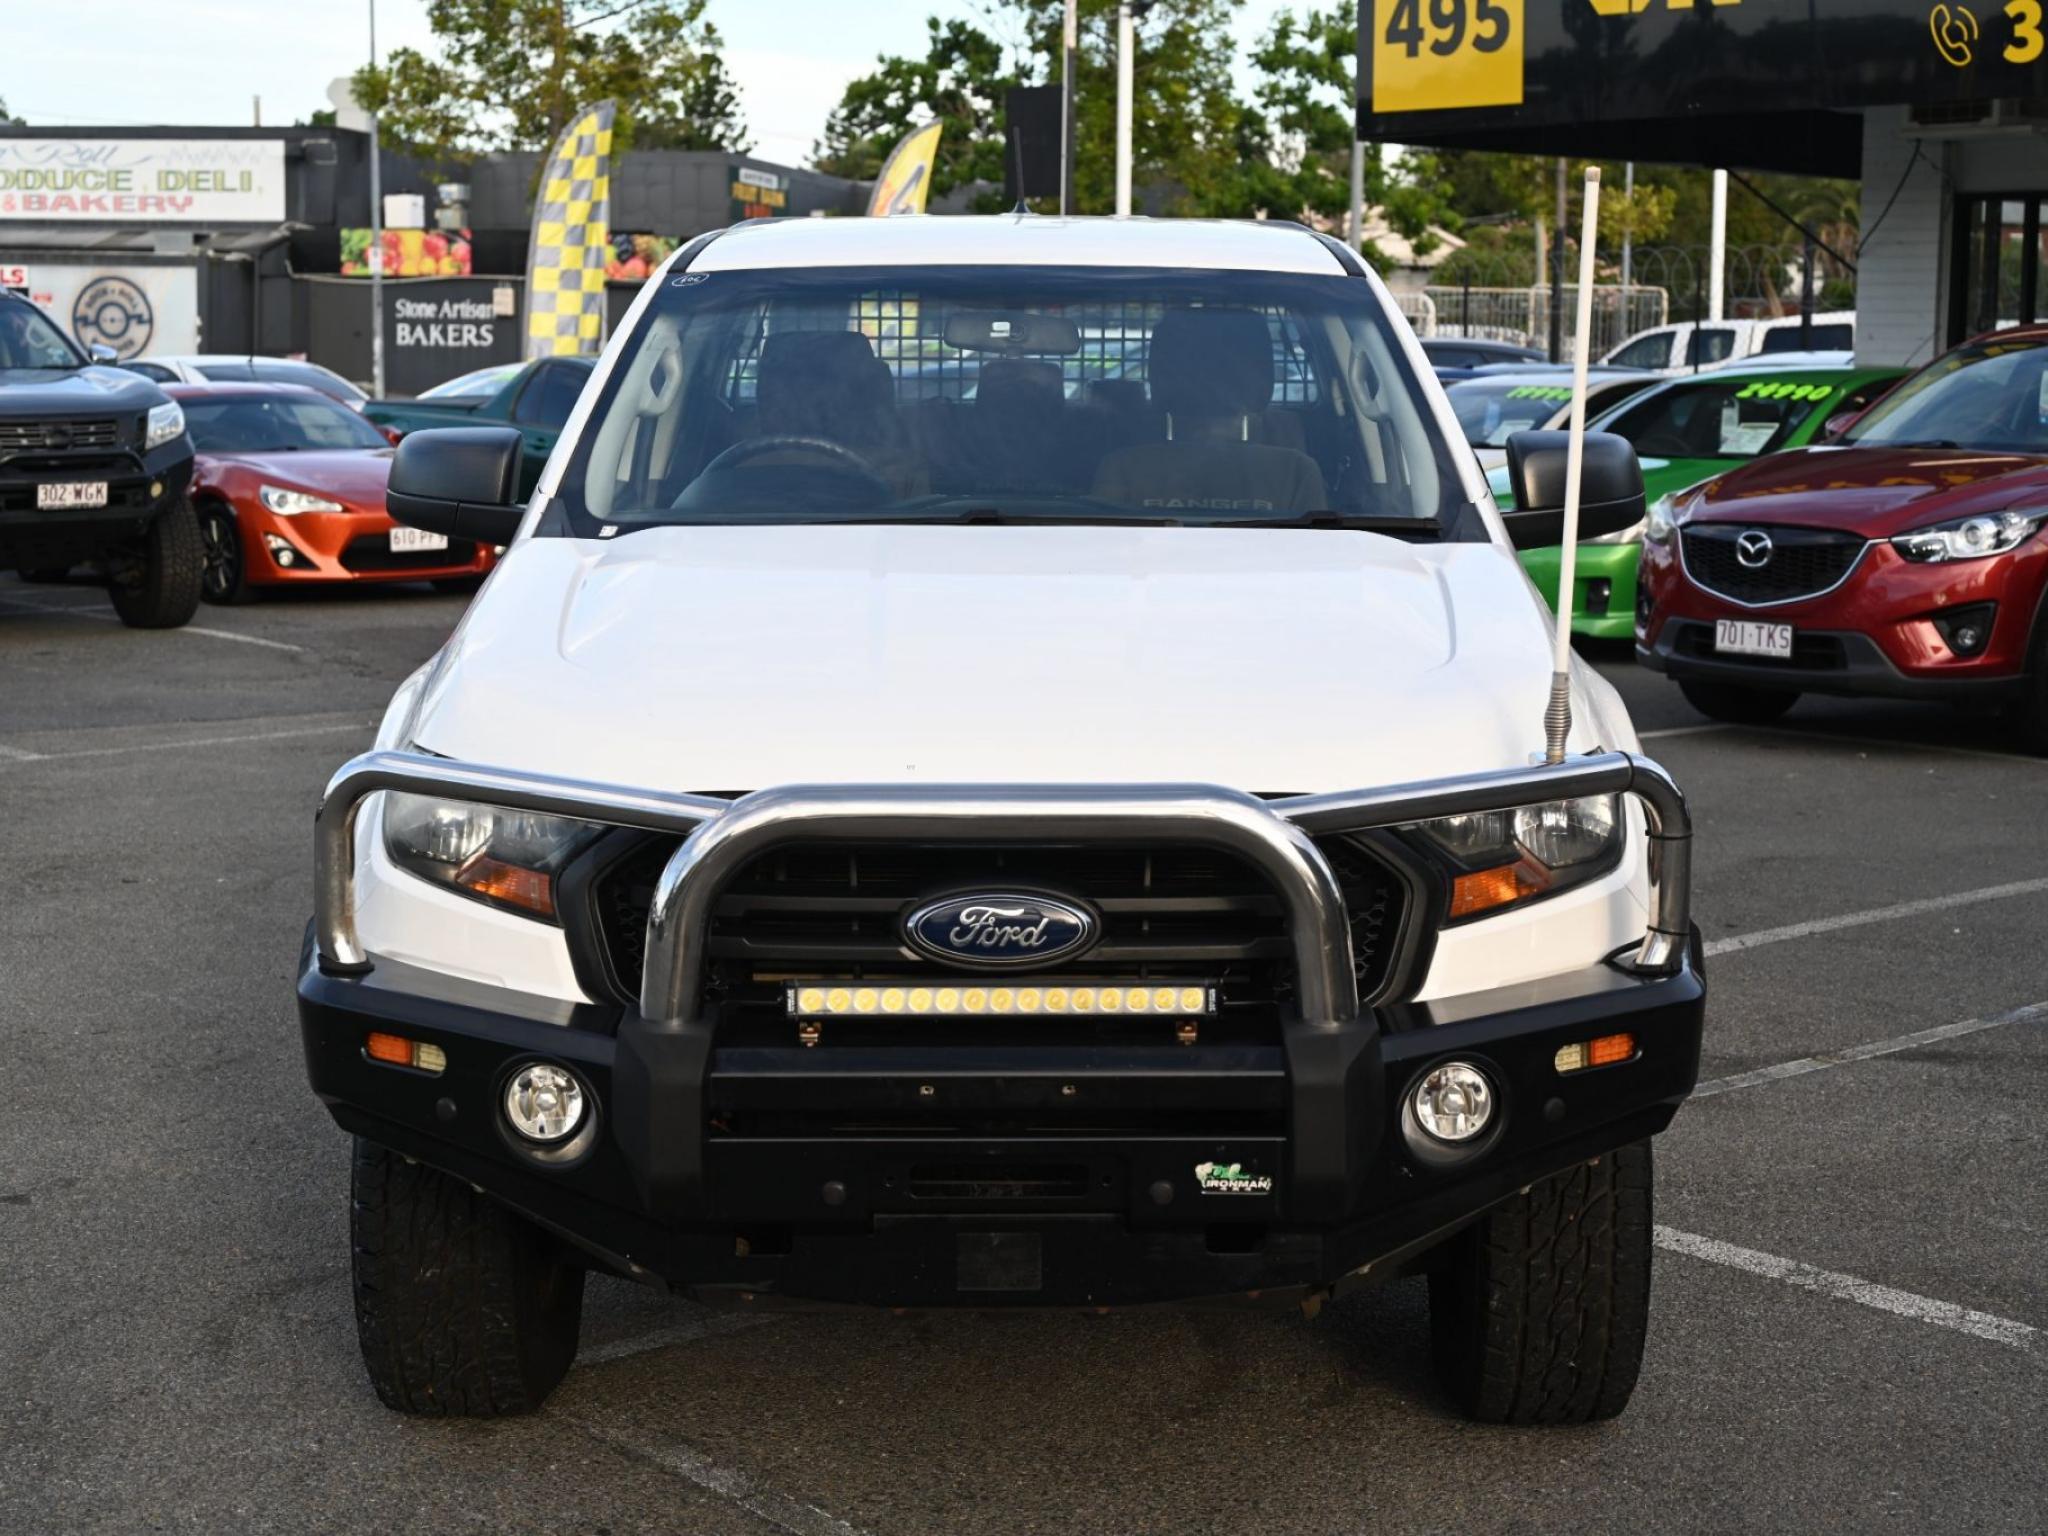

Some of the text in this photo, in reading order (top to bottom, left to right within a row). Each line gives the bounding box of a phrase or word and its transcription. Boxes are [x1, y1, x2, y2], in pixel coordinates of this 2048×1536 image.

[1384, 0, 1512, 58] 495
[2003, 0, 2045, 63] 3
[157, 170, 252, 192] DELI
[22, 194, 194, 213] BAKERY
[395, 298, 437, 318] Stone
[395, 323, 494, 347] BAKERS
[1144, 498, 1273, 510] RANGER
[949, 906, 1049, 948] Ford
[1206, 1179, 1269, 1189] IRONMAN
